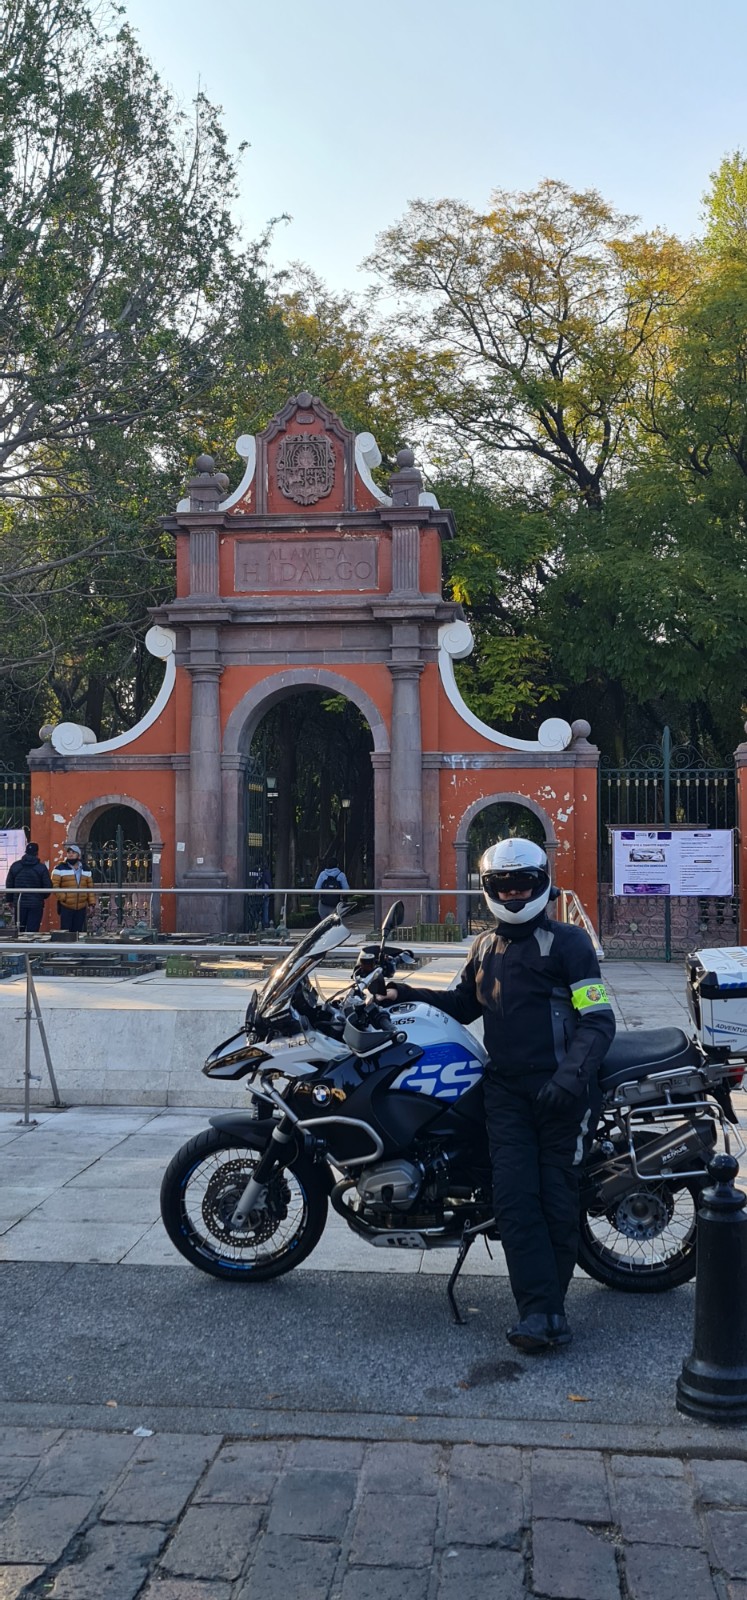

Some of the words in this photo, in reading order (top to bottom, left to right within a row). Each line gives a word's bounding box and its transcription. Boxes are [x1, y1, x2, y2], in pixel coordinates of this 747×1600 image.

[267, 547, 347, 561] ALAMEDA
[242, 561, 373, 582] HIDALGO
[389, 1060, 483, 1097] GS
